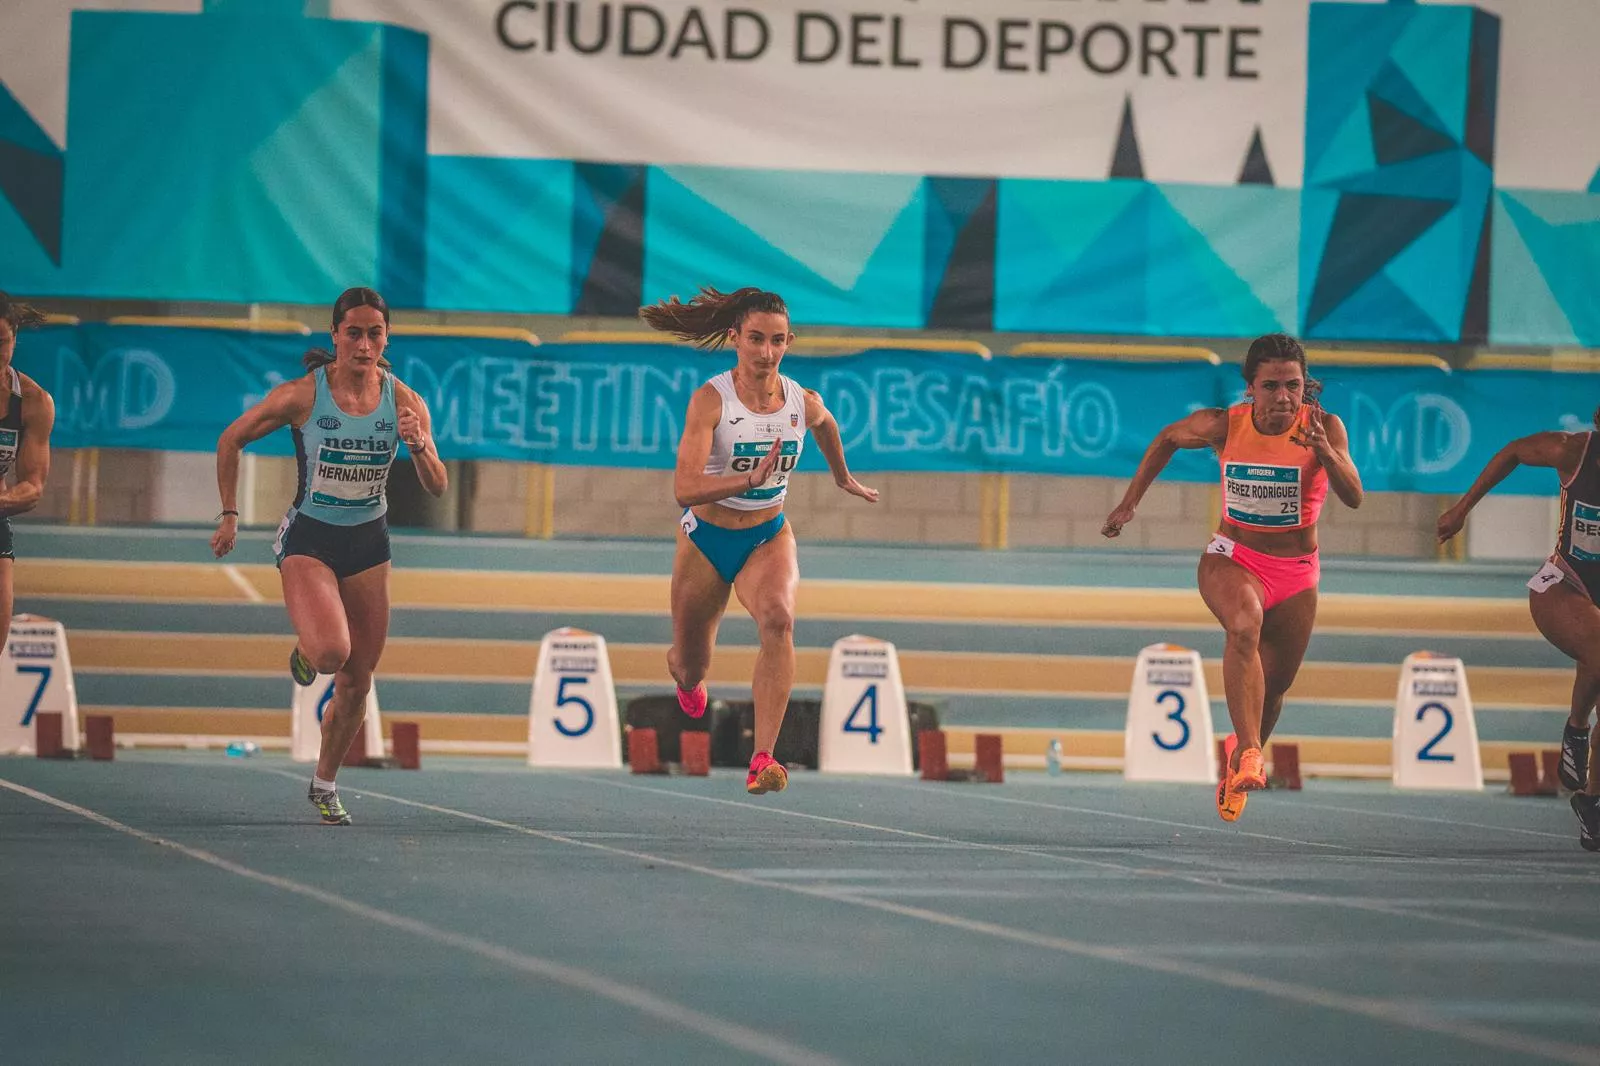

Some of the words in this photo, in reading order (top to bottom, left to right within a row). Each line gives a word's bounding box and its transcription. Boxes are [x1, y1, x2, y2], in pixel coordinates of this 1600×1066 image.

[495, 0, 771, 62] CIUDAD
[796, 11, 922, 68] DEL
[942, 16, 1262, 80] DEPORTE
[57, 346, 176, 430] MD
[405, 355, 700, 454] MEETIN
[821, 362, 1120, 458] DESAFÍO
[1351, 391, 1472, 474] MD
[318, 464, 388, 482] HERNÁNDEZ
[368, 484, 382, 496] 11
[1227, 480, 1250, 498] PÉREZ
[1252, 483, 1298, 499] RODRÍGUEZ
[1246, 468, 1276, 476] ANTEQUERA
[1280, 502, 1298, 514] 25
[16, 665, 52, 726] 7
[553, 677, 595, 737] 5
[843, 684, 884, 744] 4
[1151, 690, 1190, 751] 3
[1415, 702, 1454, 762] 2
